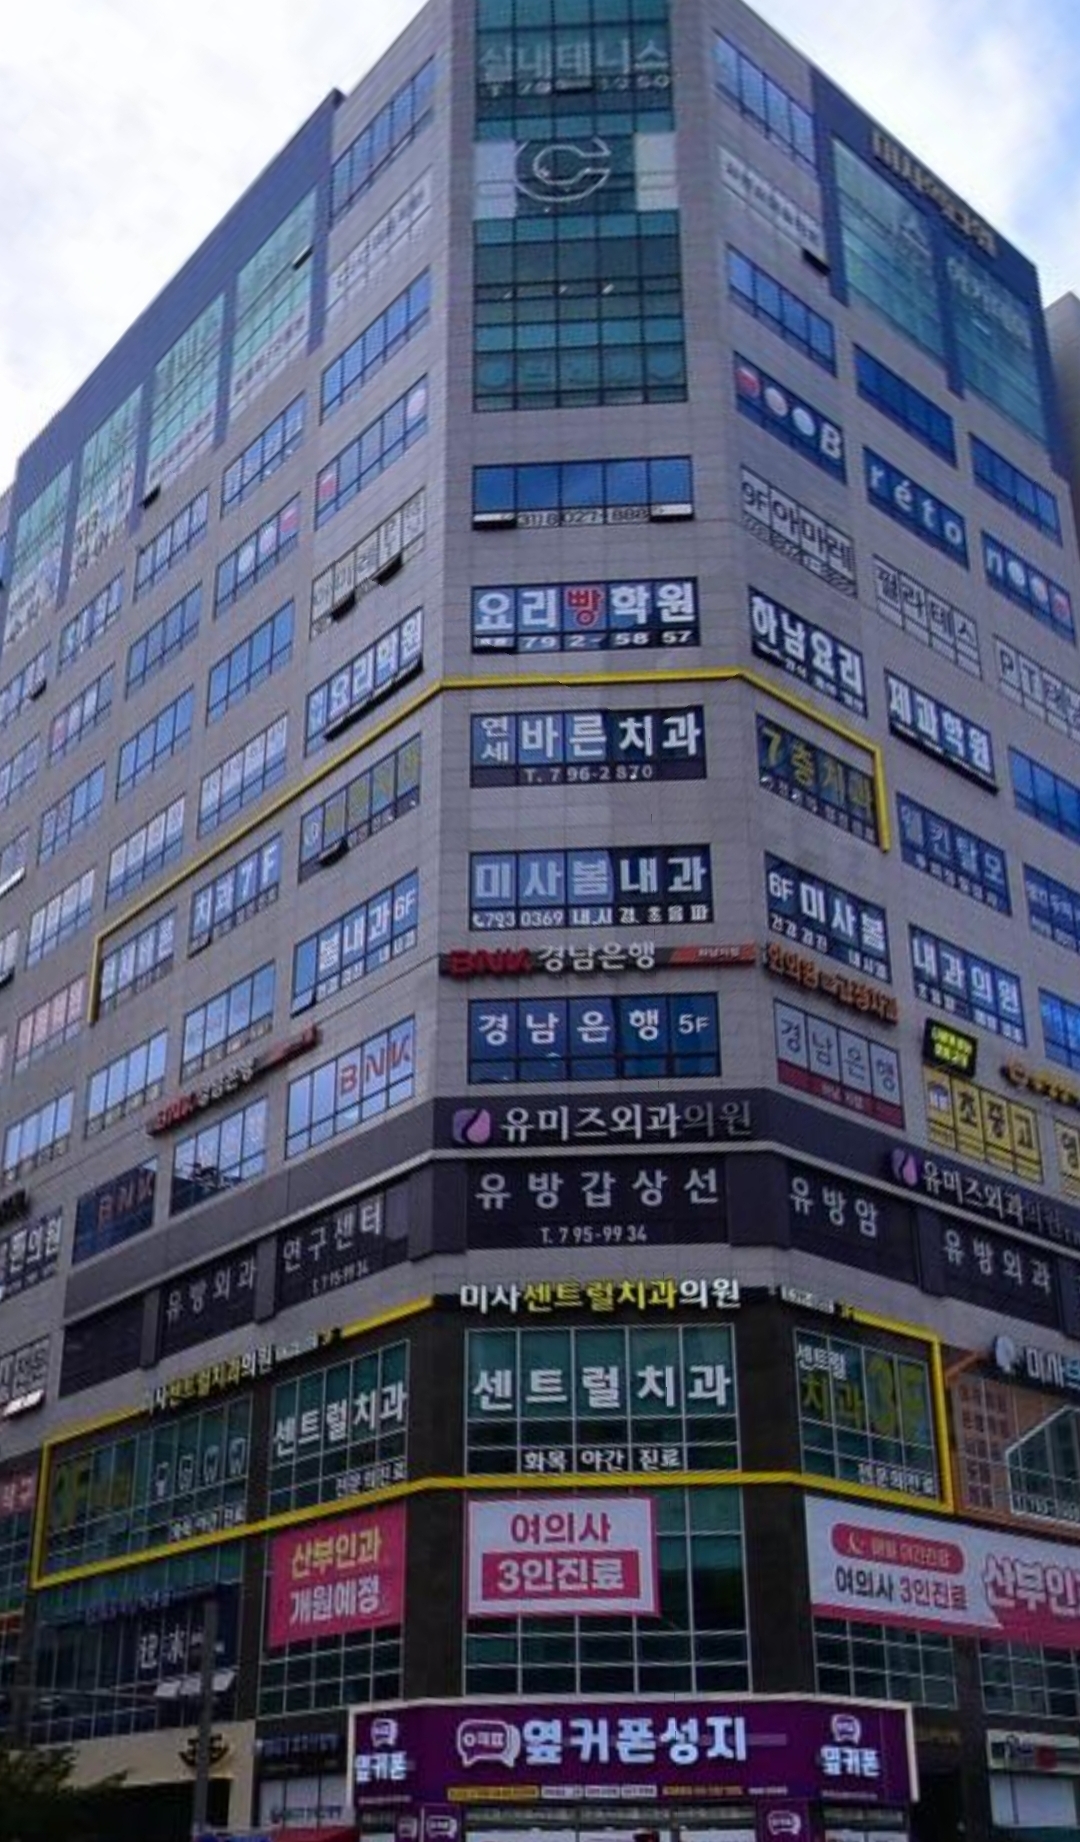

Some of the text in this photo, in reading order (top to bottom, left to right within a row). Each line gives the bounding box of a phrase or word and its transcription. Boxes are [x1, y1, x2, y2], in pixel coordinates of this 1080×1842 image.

[474, 583, 695, 631] 요리빵학원
[752, 597, 863, 698] 하남요리
[522, 712, 702, 758] 바른치과
[475, 855, 707, 899] 미사봄내과
[539, 941, 656, 973] 경남은행
[479, 1008, 710, 1046] 경남은행 5F
[780, 1018, 897, 1094] 경남은행
[502, 1100, 751, 1143] 유미즈외과의원
[790, 1177, 878, 1238] 유방암
[460, 1278, 742, 1314] 미사센트럴치과의원
[472, 1363, 732, 1412] 센트럴치과
[272, 1380, 409, 1458] 센트럴치과
[510, 1512, 612, 1545] 여의사
[291, 1525, 382, 1580] 산부인과
[498, 1558, 626, 1593] 3인진료
[836, 1565, 968, 1611] 여의사 3인진료
[982, 1552, 1080, 1617] 산부인
[523, 1716, 748, 1766] 옆커폰성지
